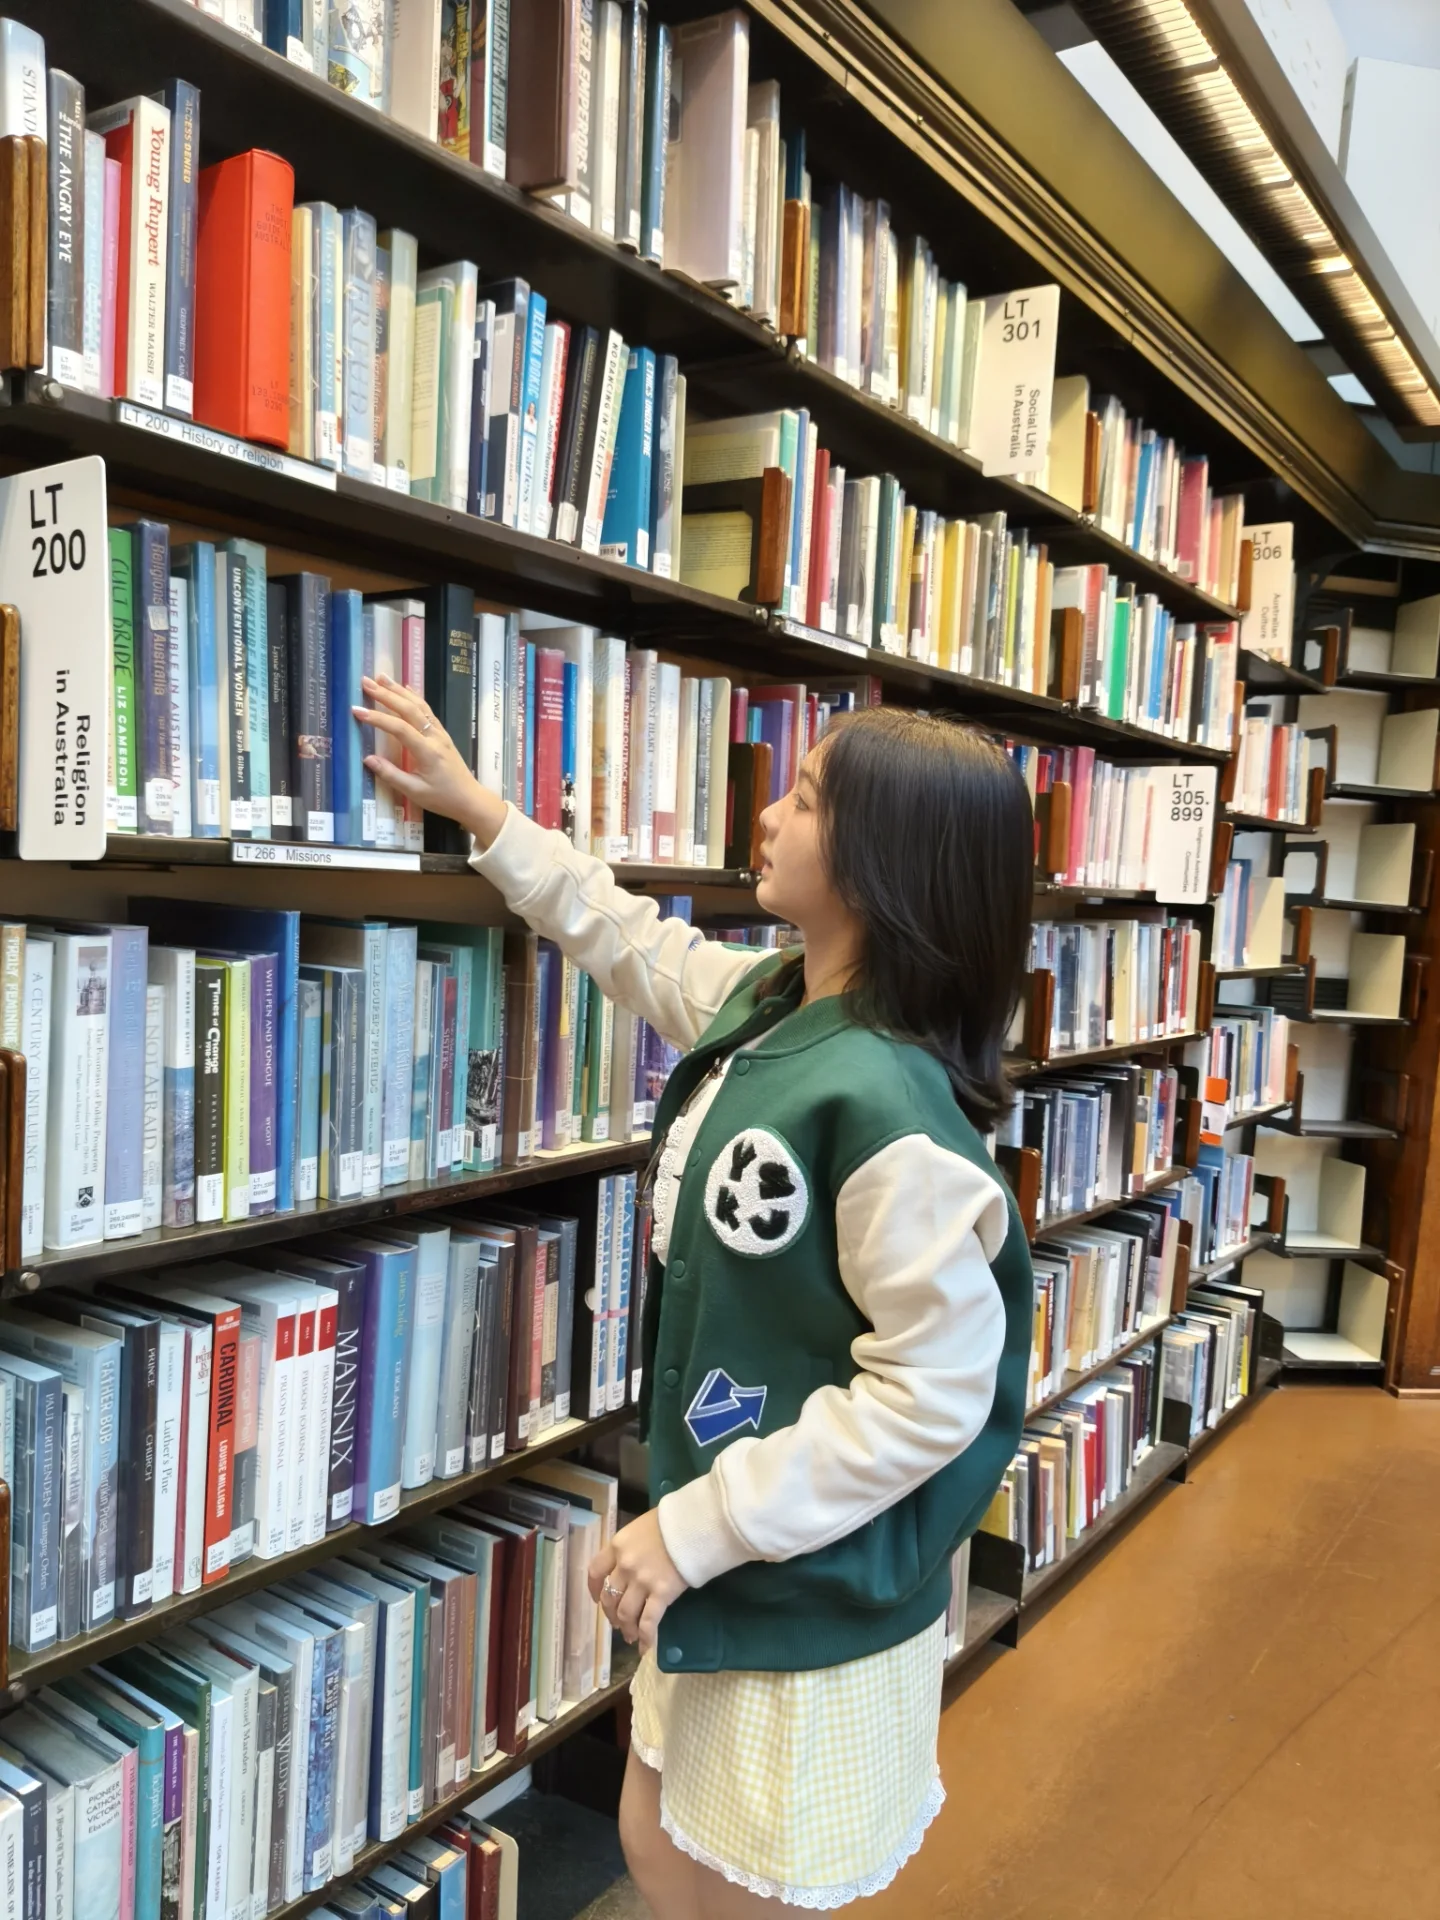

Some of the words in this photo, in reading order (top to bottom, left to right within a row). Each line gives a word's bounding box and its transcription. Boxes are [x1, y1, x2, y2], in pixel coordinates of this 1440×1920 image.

[59, 124, 72, 156] THE
[183, 98, 193, 141] ACCESS
[576, 65, 592, 174] EMPERORS
[147, 126, 165, 193] Young
[182, 143, 192, 184] DENIED
[58, 161, 73, 228] ANGRY
[58, 230, 73, 264] EYE
[145, 194, 164, 267] Rupert
[325, 227, 336, 305] MESSAGES
[148, 281, 157, 329] WALTER
[1004, 298, 1030, 320] LT
[351, 283, 371, 416] FREUD
[532, 308, 545, 357] JELENA
[611, 342, 619, 358] NO
[1002, 319, 1041, 343] 301
[146, 332, 155, 375] MARSH
[325, 330, 336, 396] BEYOND
[528, 358, 541, 400] DOKIC
[604, 360, 617, 410] DANCING
[645, 361, 654, 397] ETHICS
[1015, 384, 1025, 396] in
[601, 413, 610, 424] IN
[644, 399, 653, 433] UNDER
[1027, 388, 1040, 429] Social
[123, 406, 140, 423] LT
[145, 413, 170, 433] 200
[182, 425, 224, 455] History
[228, 442, 240, 457] of
[243, 446, 284, 471] religion
[598, 429, 608, 449] THE
[643, 434, 652, 458] FIRE
[1009, 400, 1024, 459] Australia
[1024, 431, 1037, 457] Life
[594, 454, 605, 480] LIFT
[30, 482, 64, 530] LT
[32, 529, 87, 578] 200
[1253, 531, 1272, 545] LT
[1253, 545, 1282, 560] 306
[111, 557, 129, 607] CULT
[169, 588, 179, 617] THE
[232, 567, 244, 669] UNCONVENTIONAL
[318, 593, 326, 620] NEW
[1260, 606, 1270, 640] Culture
[1271, 593, 1281, 639] Australian
[112, 616, 132, 679] BRIDE
[153, 632, 165, 696] Australia
[169, 625, 179, 670] BIBLE
[318, 622, 327, 686] TESTAMENT
[56, 669, 71, 694] in
[117, 685, 127, 709] LIZ
[170, 677, 180, 694] IN
[235, 672, 244, 717] WOMEN
[493, 660, 502, 722] CHALLENGE
[623, 661, 631, 700] ANGELS
[319, 687, 328, 732] HISTORY
[117, 714, 128, 787] CAMERON
[170, 703, 181, 790] AUSTRALIA
[236, 730, 245, 754] Sarah
[622, 735, 630, 782] OUTBACK
[54, 701, 71, 827] Australia
[71, 713, 91, 827] Religion
[236, 755, 245, 784] Gilbert
[1172, 773, 1194, 788] LT
[1170, 806, 1203, 822] 899
[1171, 790, 1210, 806] 305.
[236, 846, 251, 858] LT
[254, 846, 276, 860] 266
[286, 848, 332, 863] Missions
[6, 937, 20, 977] TRULY
[369, 937, 382, 960] THE
[32, 972, 41, 983] A
[207, 979, 221, 1017] Times
[264, 969, 273, 996] WITH
[4, 983, 19, 1045] FEMININE
[29, 988, 41, 1061] CENTURY
[147, 996, 160, 1018] BE
[264, 998, 273, 1017] PEN
[96, 1028, 104, 1044] The
[145, 1024, 160, 1068] NOT
[207, 1027, 221, 1074] Change
[264, 1020, 273, 1042] AND
[442, 1028, 450, 1069] SISTERS
[28, 1066, 40, 1084] OF
[95, 1047, 104, 1086] Fountain
[204, 1041, 212, 1074] 1918-1978
[264, 1044, 273, 1087] TONGUE
[26, 1089, 40, 1176] INFLUENCE
[93, 1101, 102, 1127] Public
[143, 1075, 158, 1150] AFRAID
[91, 1130, 101, 1174] Prosperity
[615, 1206, 623, 1260] AUSTRALIA
[534, 1249, 546, 1289] SACRED
[532, 1292, 545, 1341] THREADS
[100, 1360, 116, 1412] FATHER
[147, 1348, 156, 1387] PRINCE
[216, 1342, 236, 1433] CARDINAL
[321, 1364, 330, 1405] PRISON
[45, 1393, 55, 1425] PAUL
[278, 1374, 288, 1416] PRISON
[300, 1370, 309, 1411] PRISON
[331, 1326, 360, 1472] MANNIX
[99, 1415, 114, 1445] BOB
[162, 1418, 175, 1465] Luther's
[241, 1413, 253, 1444] Pell
[277, 1419, 287, 1471] JOURNAL
[297, 1414, 307, 1465] JOURNAL
[318, 1408, 329, 1457] JOURNAL
[43, 1427, 54, 1508] CRITTENDEN
[100, 1449, 111, 1467] The
[145, 1434, 154, 1481] CHURCH
[218, 1440, 229, 1471] LOUISE
[99, 1469, 111, 1505] Larrikin
[160, 1468, 173, 1495] Pine
[216, 1473, 227, 1518] MILLIGAN
[39, 1512, 51, 1557] Changing
[99, 1507, 110, 1535] Priest
[40, 1558, 50, 1591] Orders
[448, 1596, 456, 1636] CHURCH
[242, 1689, 252, 1727] Samuel
[241, 1728, 251, 1775] Marsden
[276, 1731, 291, 1778] WILD
[86, 1788, 122, 1815] CATHOLIC
[87, 1799, 122, 1823] VICTORIA
[88, 1780, 120, 1804] PIONEER
[277, 1782, 288, 1809] MAN
